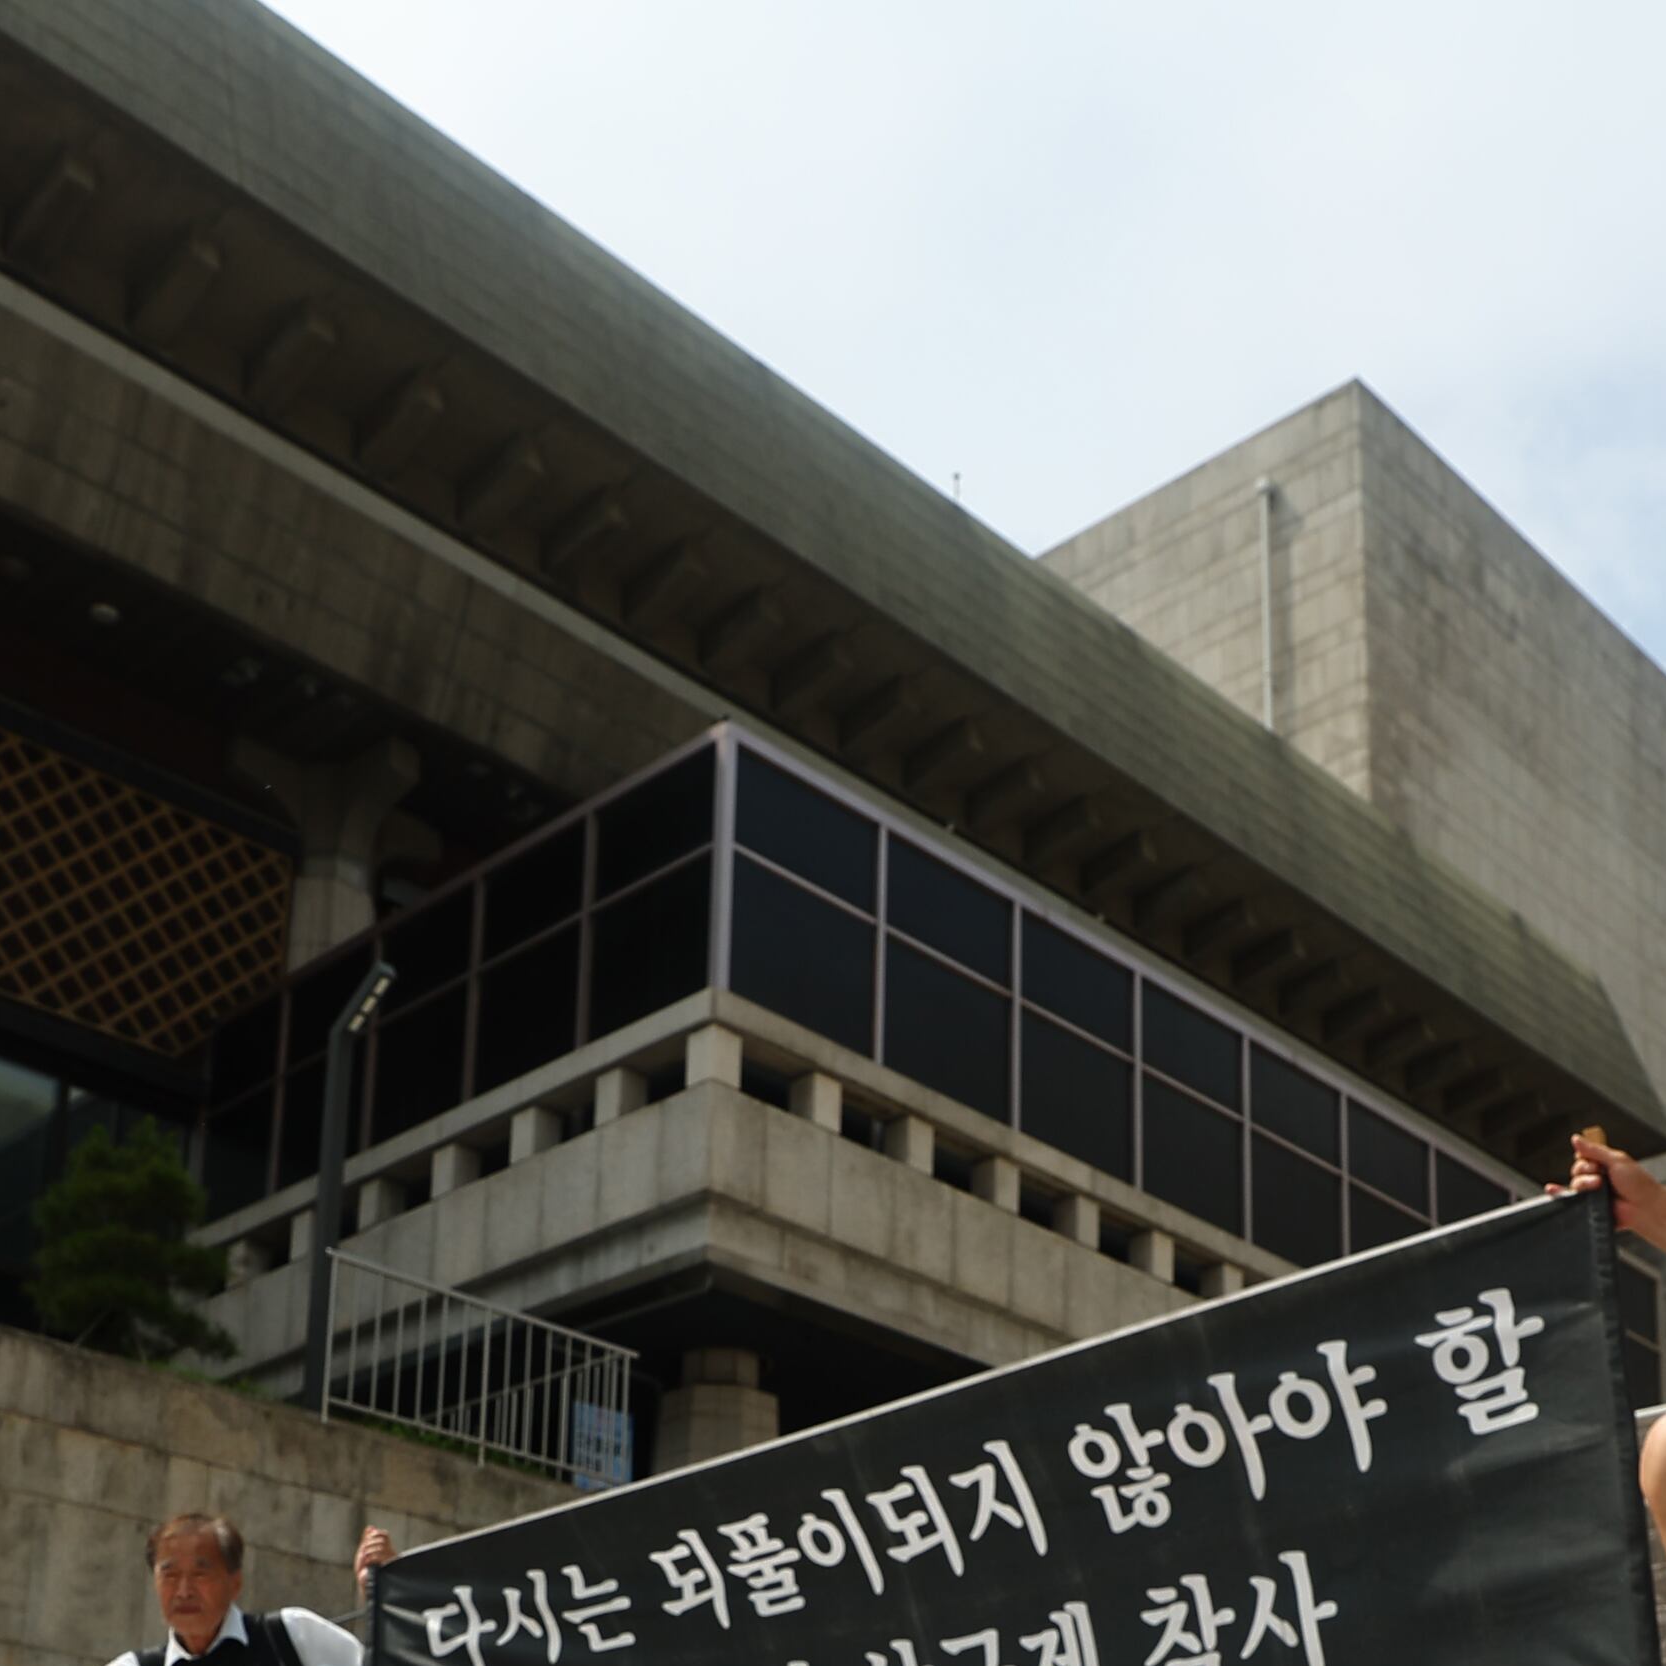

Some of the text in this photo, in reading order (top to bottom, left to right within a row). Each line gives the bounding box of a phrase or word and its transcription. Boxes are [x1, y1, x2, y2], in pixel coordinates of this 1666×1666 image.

[650, 1441, 1046, 1627] 되풀이되지
[1069, 1341, 1386, 1532] 않아야
[1415, 1289, 1543, 1434] 할
